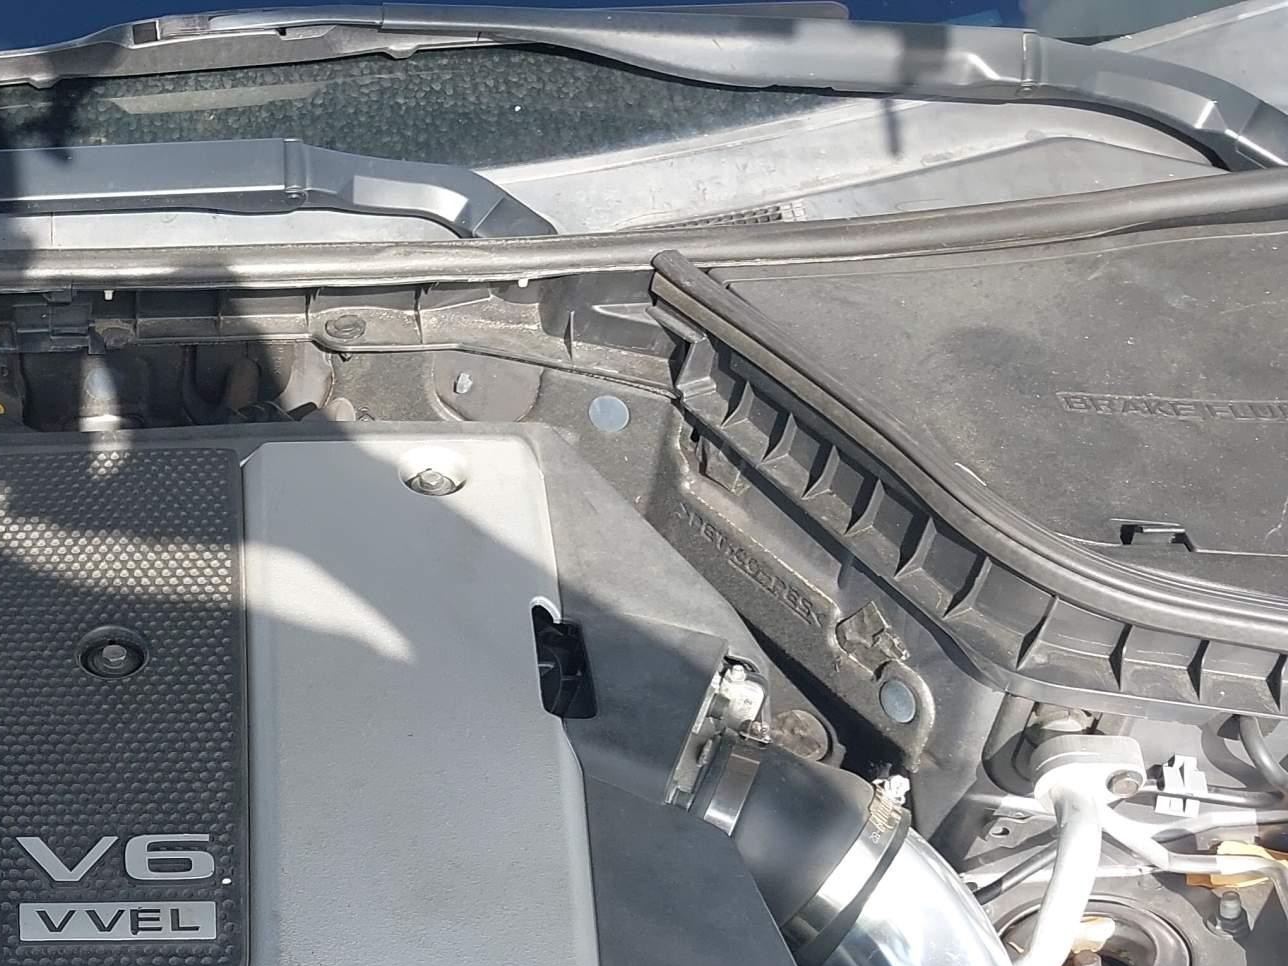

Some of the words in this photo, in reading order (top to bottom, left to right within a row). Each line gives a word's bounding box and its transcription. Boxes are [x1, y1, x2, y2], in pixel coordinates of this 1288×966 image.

[1062, 396, 1203, 421] BRAKE
[15, 833, 215, 882] V6
[34, 907, 200, 935] VVEL
